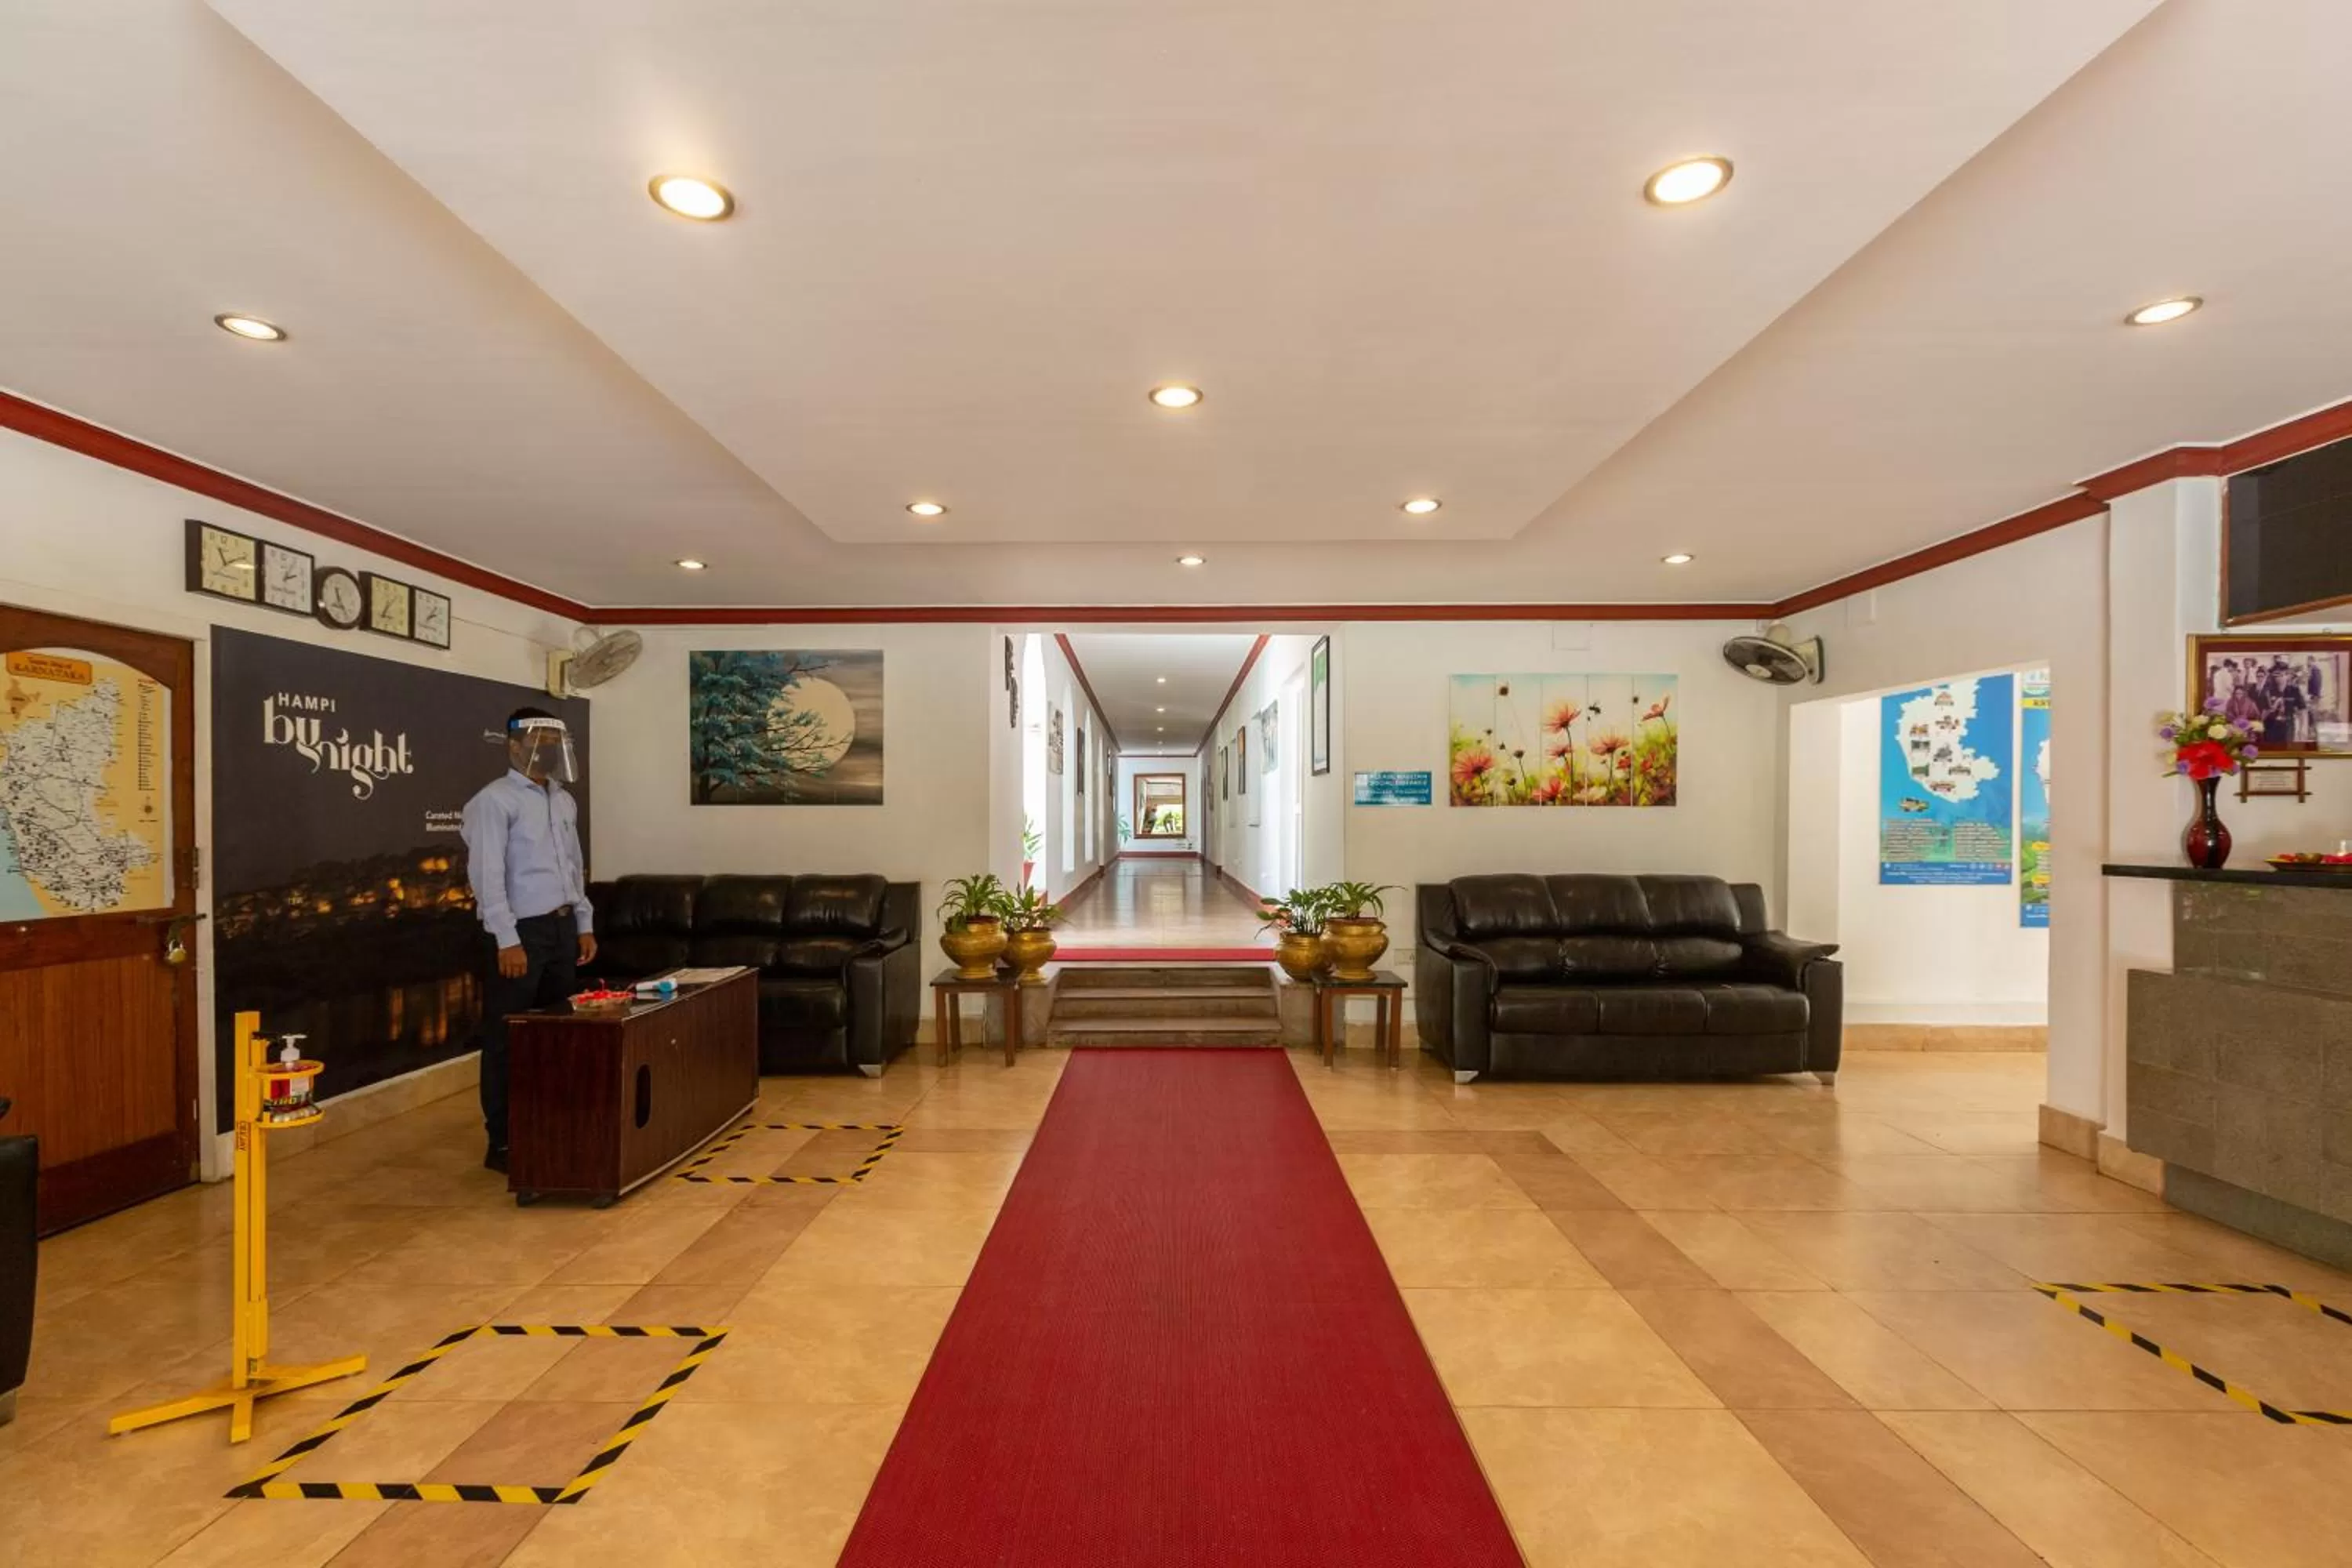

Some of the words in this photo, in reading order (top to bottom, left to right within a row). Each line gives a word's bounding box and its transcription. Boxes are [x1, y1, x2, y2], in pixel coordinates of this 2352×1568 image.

[13, 662, 85, 680] KARNATAKA
[278, 691, 336, 713] HAMPI
[263, 695, 321, 774] by
[314, 728, 414, 800] night
